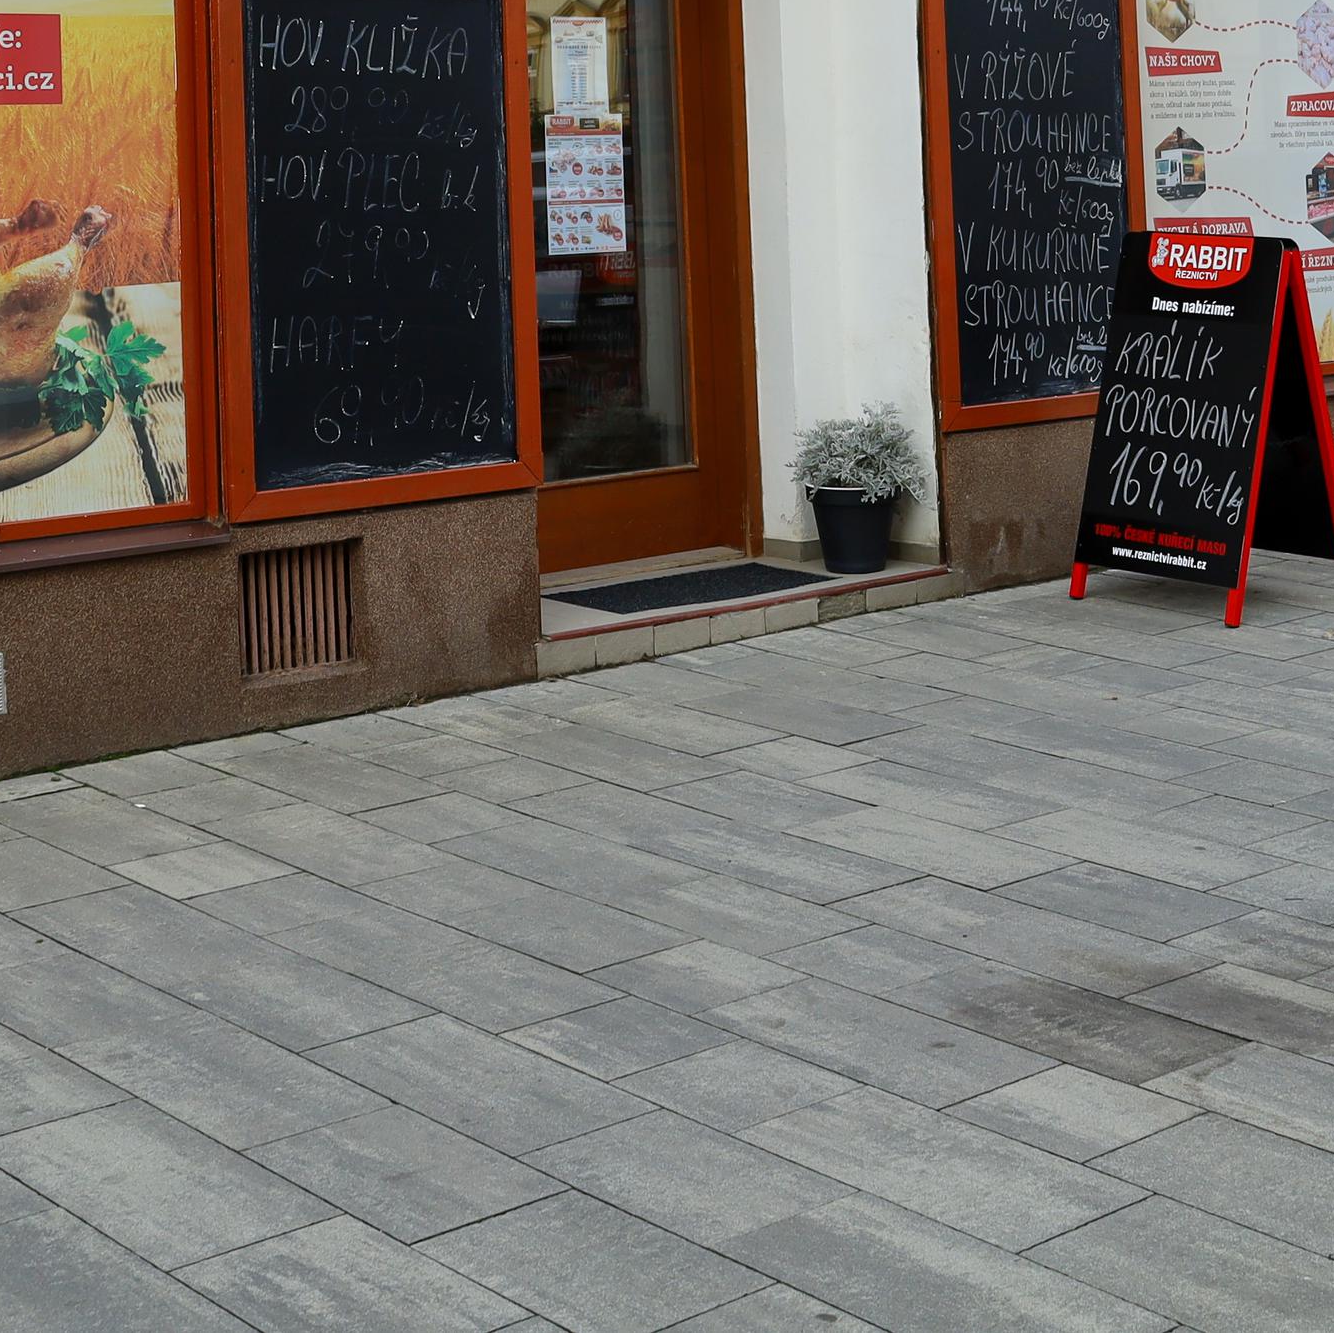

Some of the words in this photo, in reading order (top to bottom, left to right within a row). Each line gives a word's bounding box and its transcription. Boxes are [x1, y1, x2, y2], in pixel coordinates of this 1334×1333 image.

[1149, 52, 1178, 67] NAŠE
[1180, 54, 1216, 67] CHOVY
[954, 52, 970, 99] V
[957, 106, 1112, 155] STROUHANCE
[1201, 222, 1248, 235] DOPRAVA
[958, 221, 975, 274] V
[1169, 243, 1247, 272] RABBIT
[1175, 268, 1218, 281] ŘEZNICTVÍ
[1151, 296, 1179, 312] Dnes
[1182, 300, 1235, 317] nabízíme:
[1114, 319, 1224, 382] KRÁLÍK
[1104, 384, 1258, 449] PORCOVANÝ
[1124, 524, 1156, 545] ČESKÉ
[1197, 538, 1227, 556] MASO
[1112, 546, 1208, 571] www.reznictvirabbit.cz
